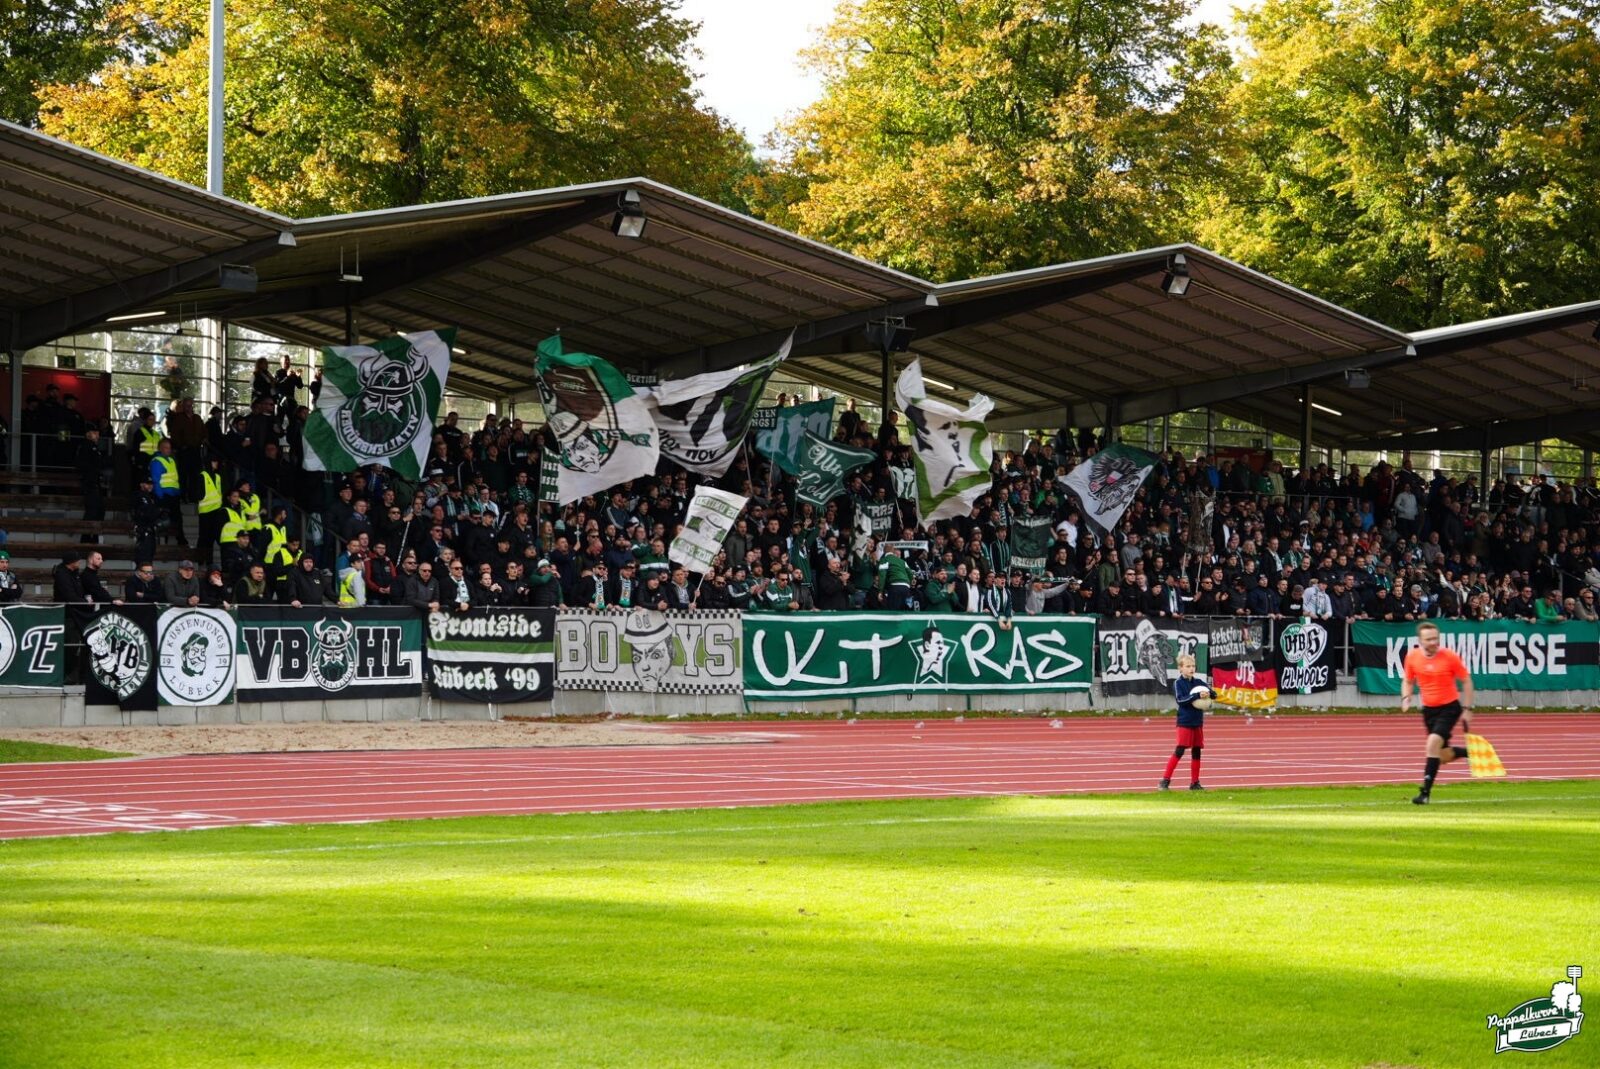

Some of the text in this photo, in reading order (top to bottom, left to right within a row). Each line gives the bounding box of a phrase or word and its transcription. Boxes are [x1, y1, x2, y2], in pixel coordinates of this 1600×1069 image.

[754, 409, 776, 418] STEN
[428, 611, 542, 641] Frontside
[162, 657, 227, 666] 19 19
[752, 622, 1084, 686] ULTRAS
[1386, 631, 1567, 678] KMMESSE
[432, 664, 499, 690] Lübeck
